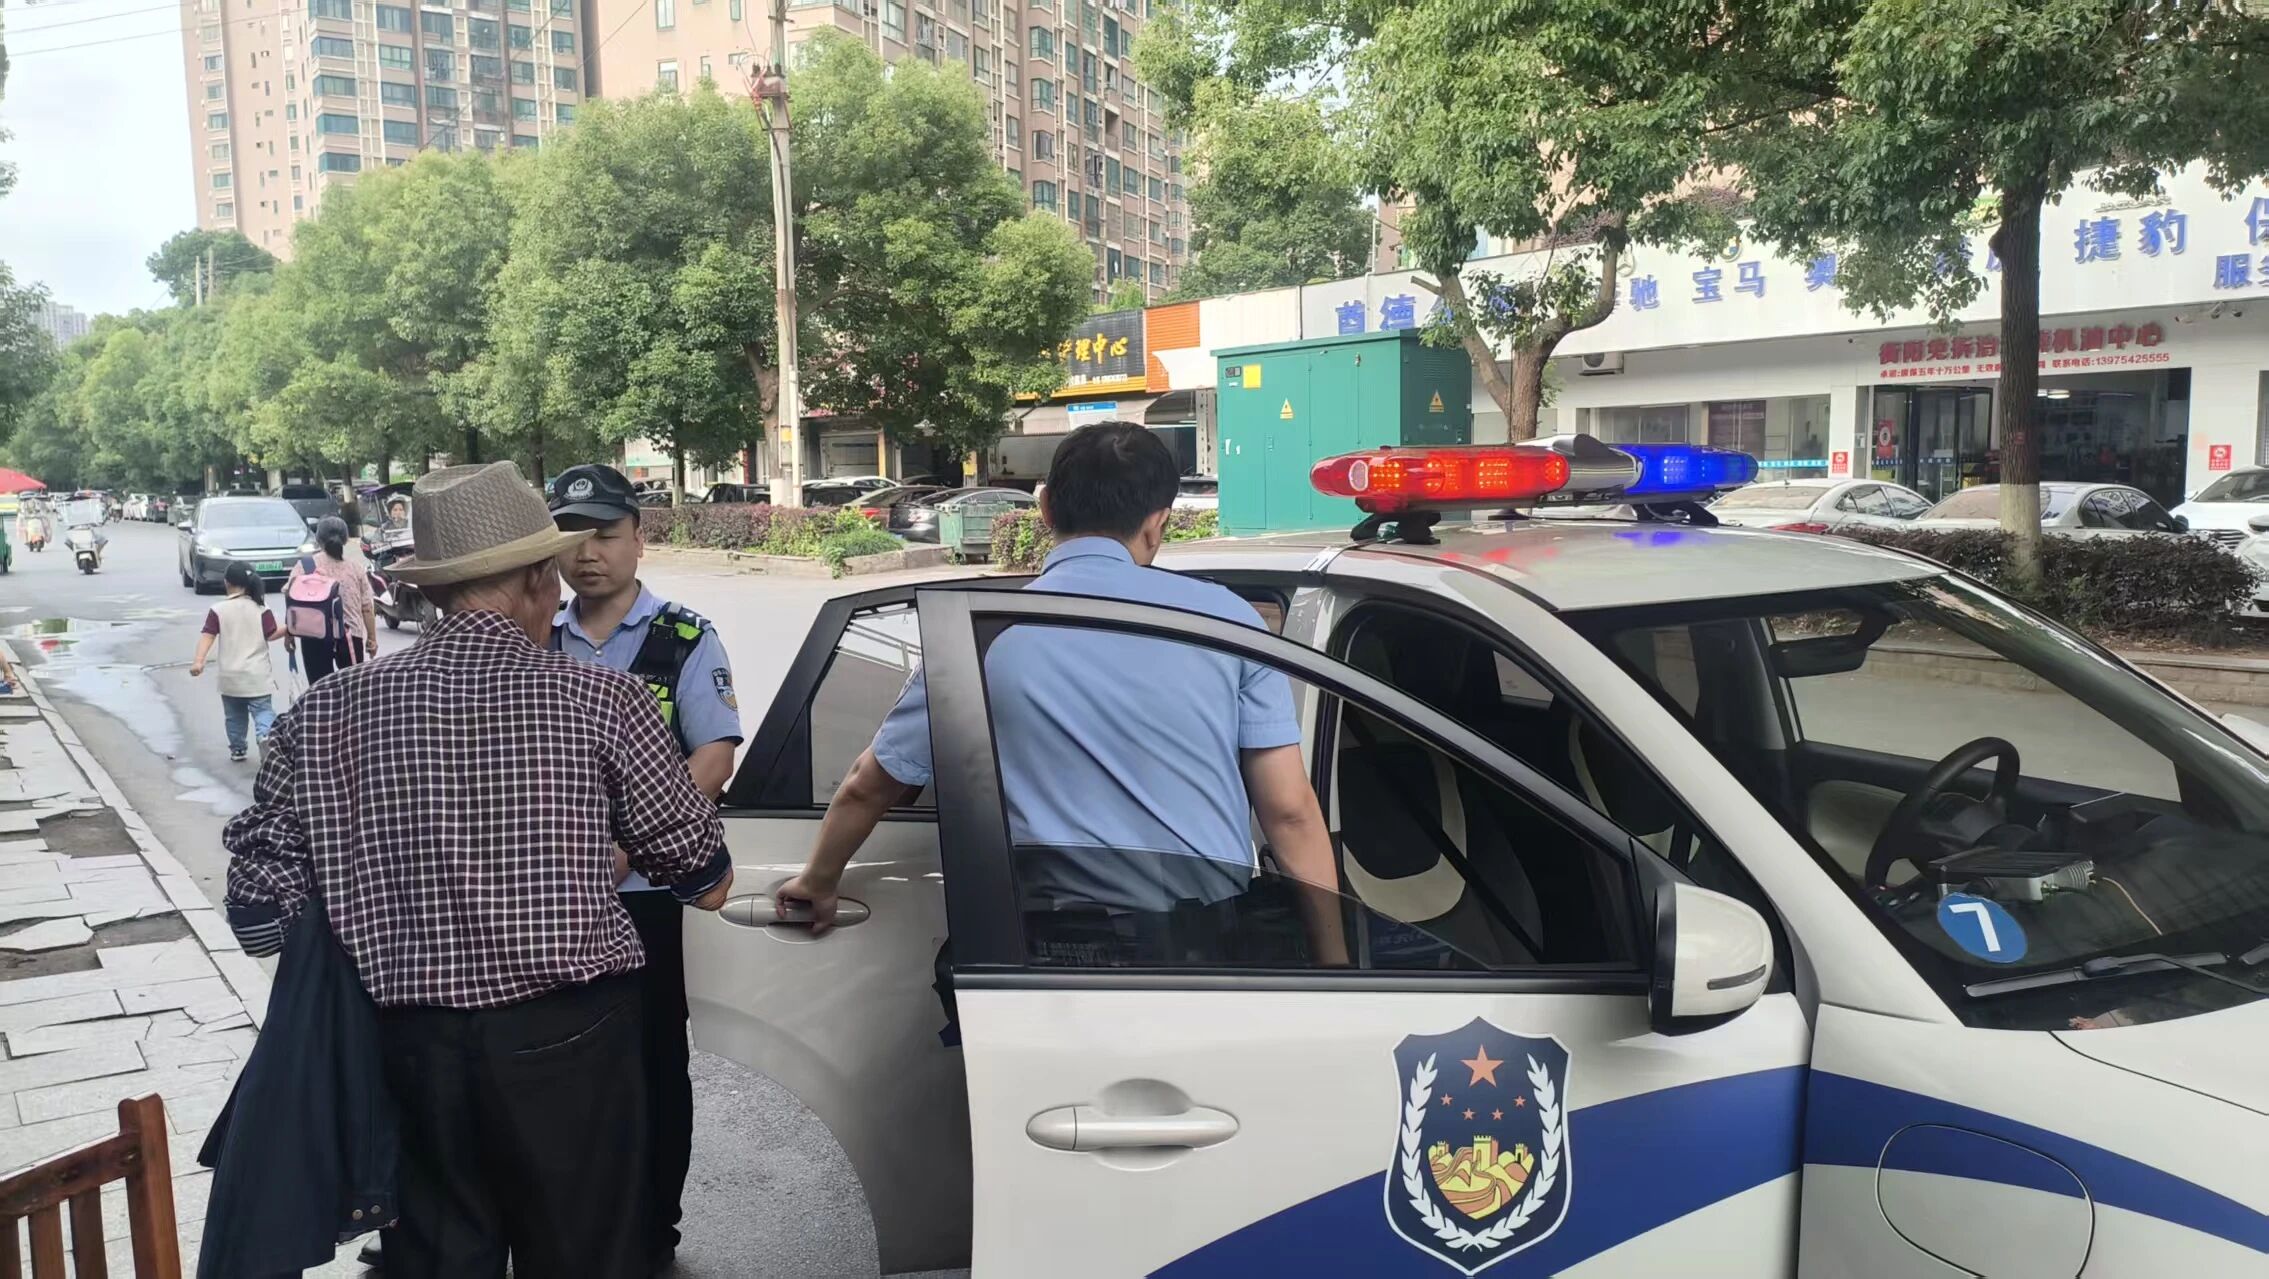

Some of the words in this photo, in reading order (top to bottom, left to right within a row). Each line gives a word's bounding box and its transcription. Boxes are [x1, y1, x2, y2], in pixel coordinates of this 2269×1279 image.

[1692, 261, 1767, 304] 宝马
[2074, 208, 2187, 264] 捷豹
[1948, 902, 2001, 953] 7
